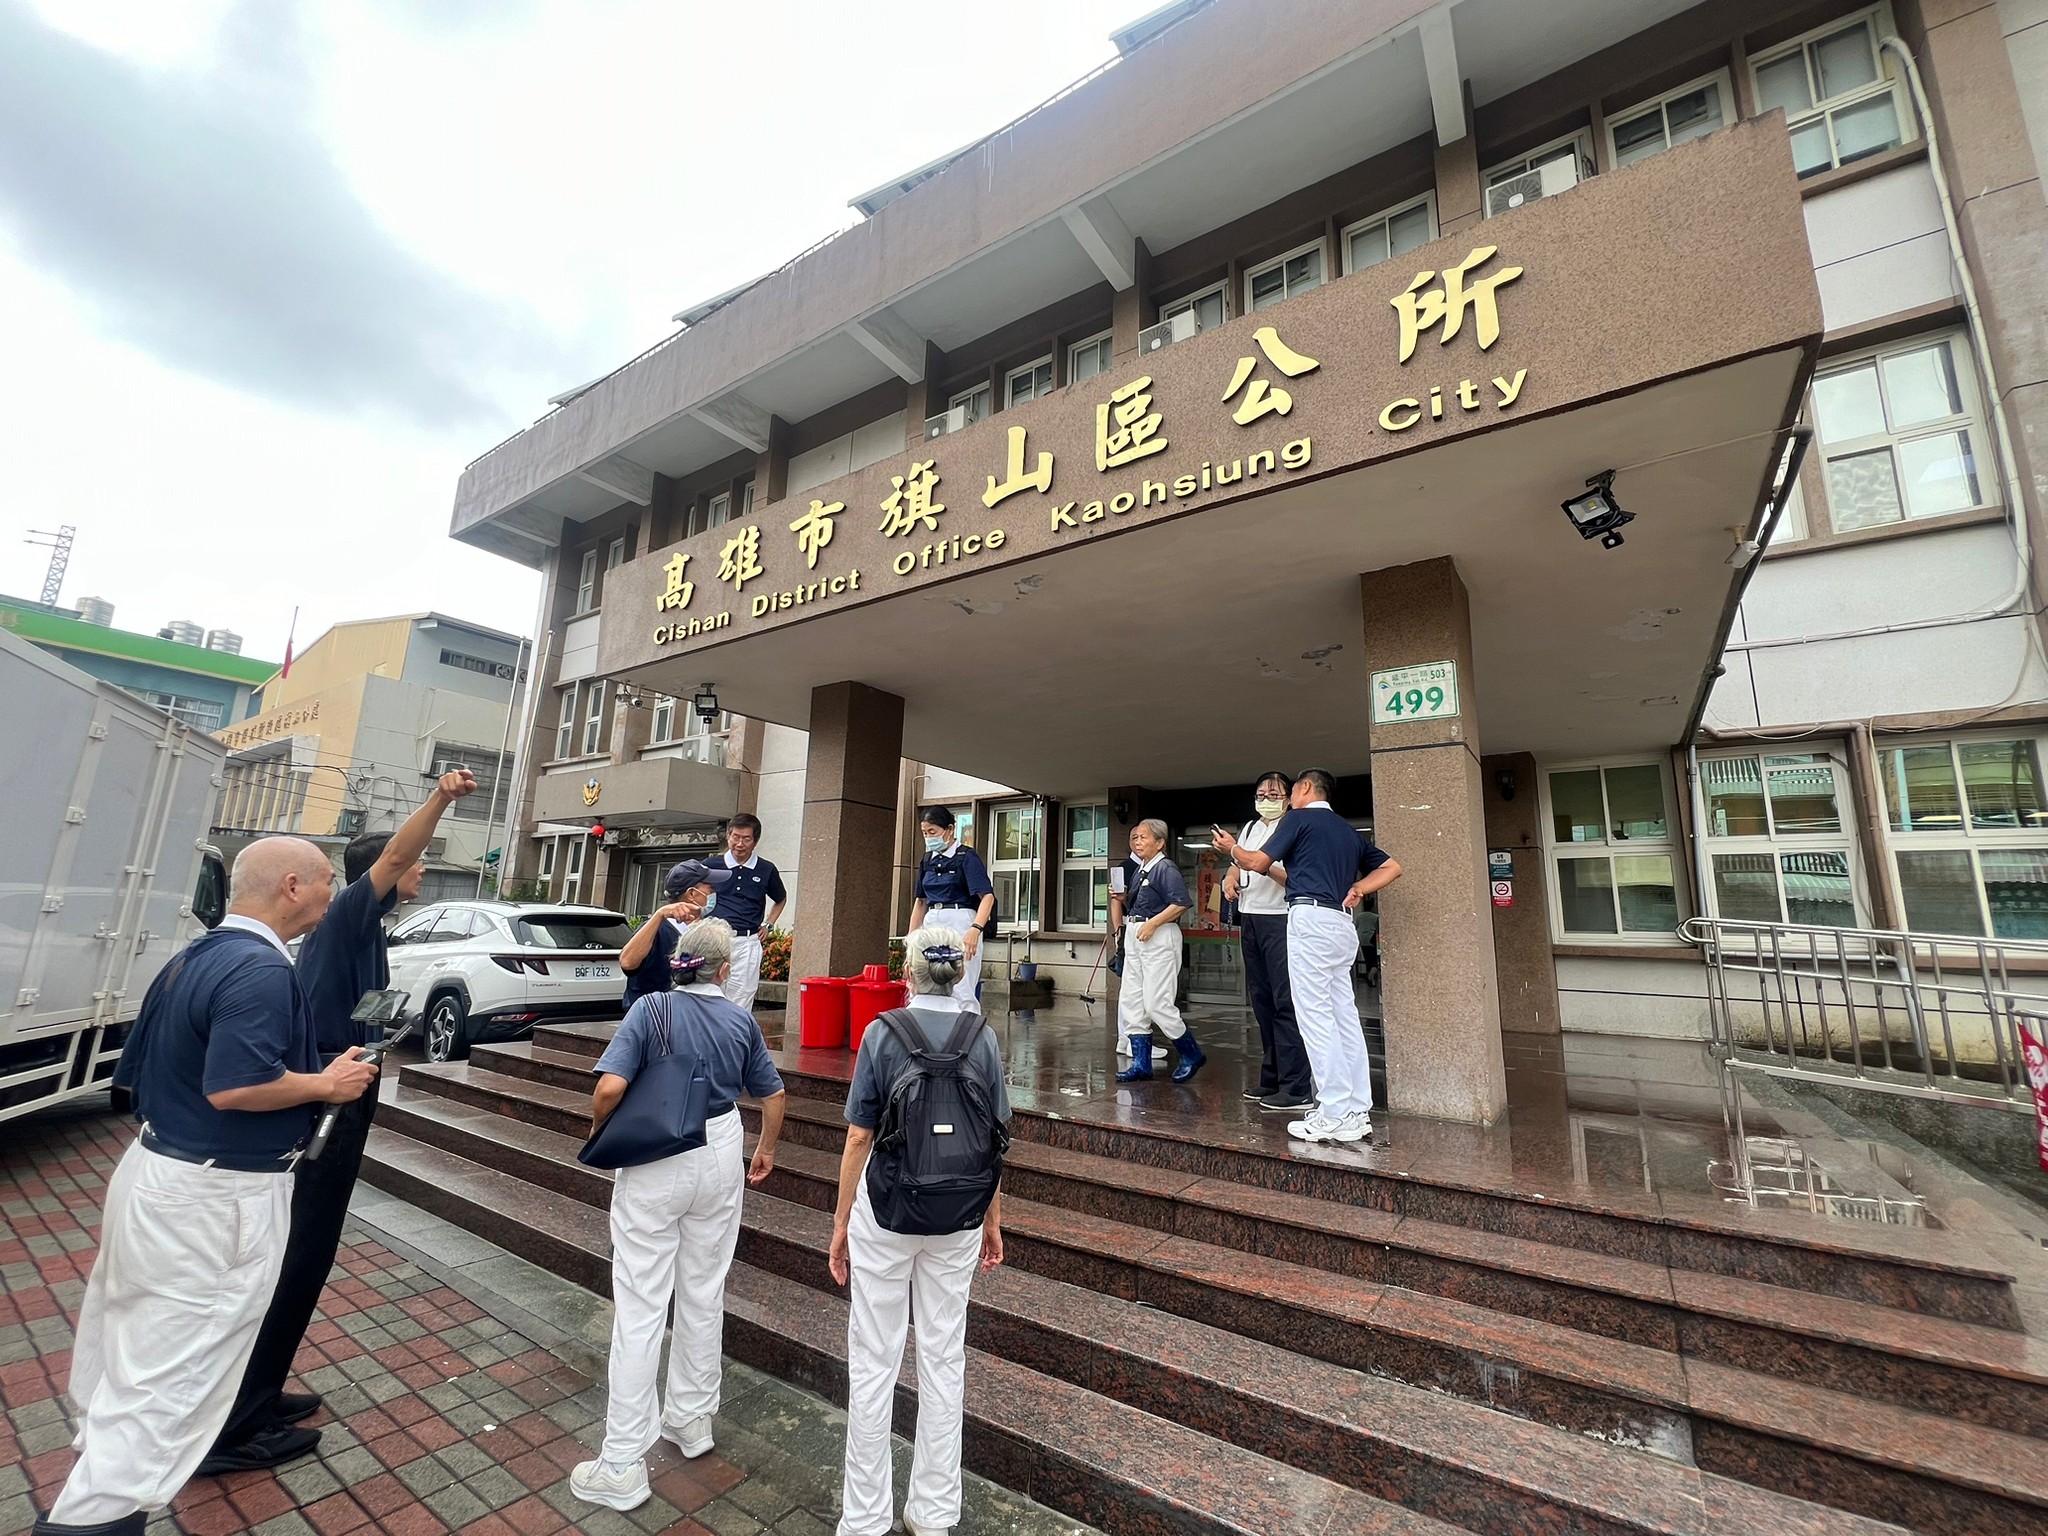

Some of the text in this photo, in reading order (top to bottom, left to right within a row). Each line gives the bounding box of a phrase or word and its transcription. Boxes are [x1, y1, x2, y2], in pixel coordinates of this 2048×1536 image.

[656, 244, 1525, 614] 高雄市旗山區公所
[653, 368, 1528, 646] Cishan District Office Kaohsiung City
[1385, 686, 1444, 716] 499
[1430, 668, 1446, 680] 503
